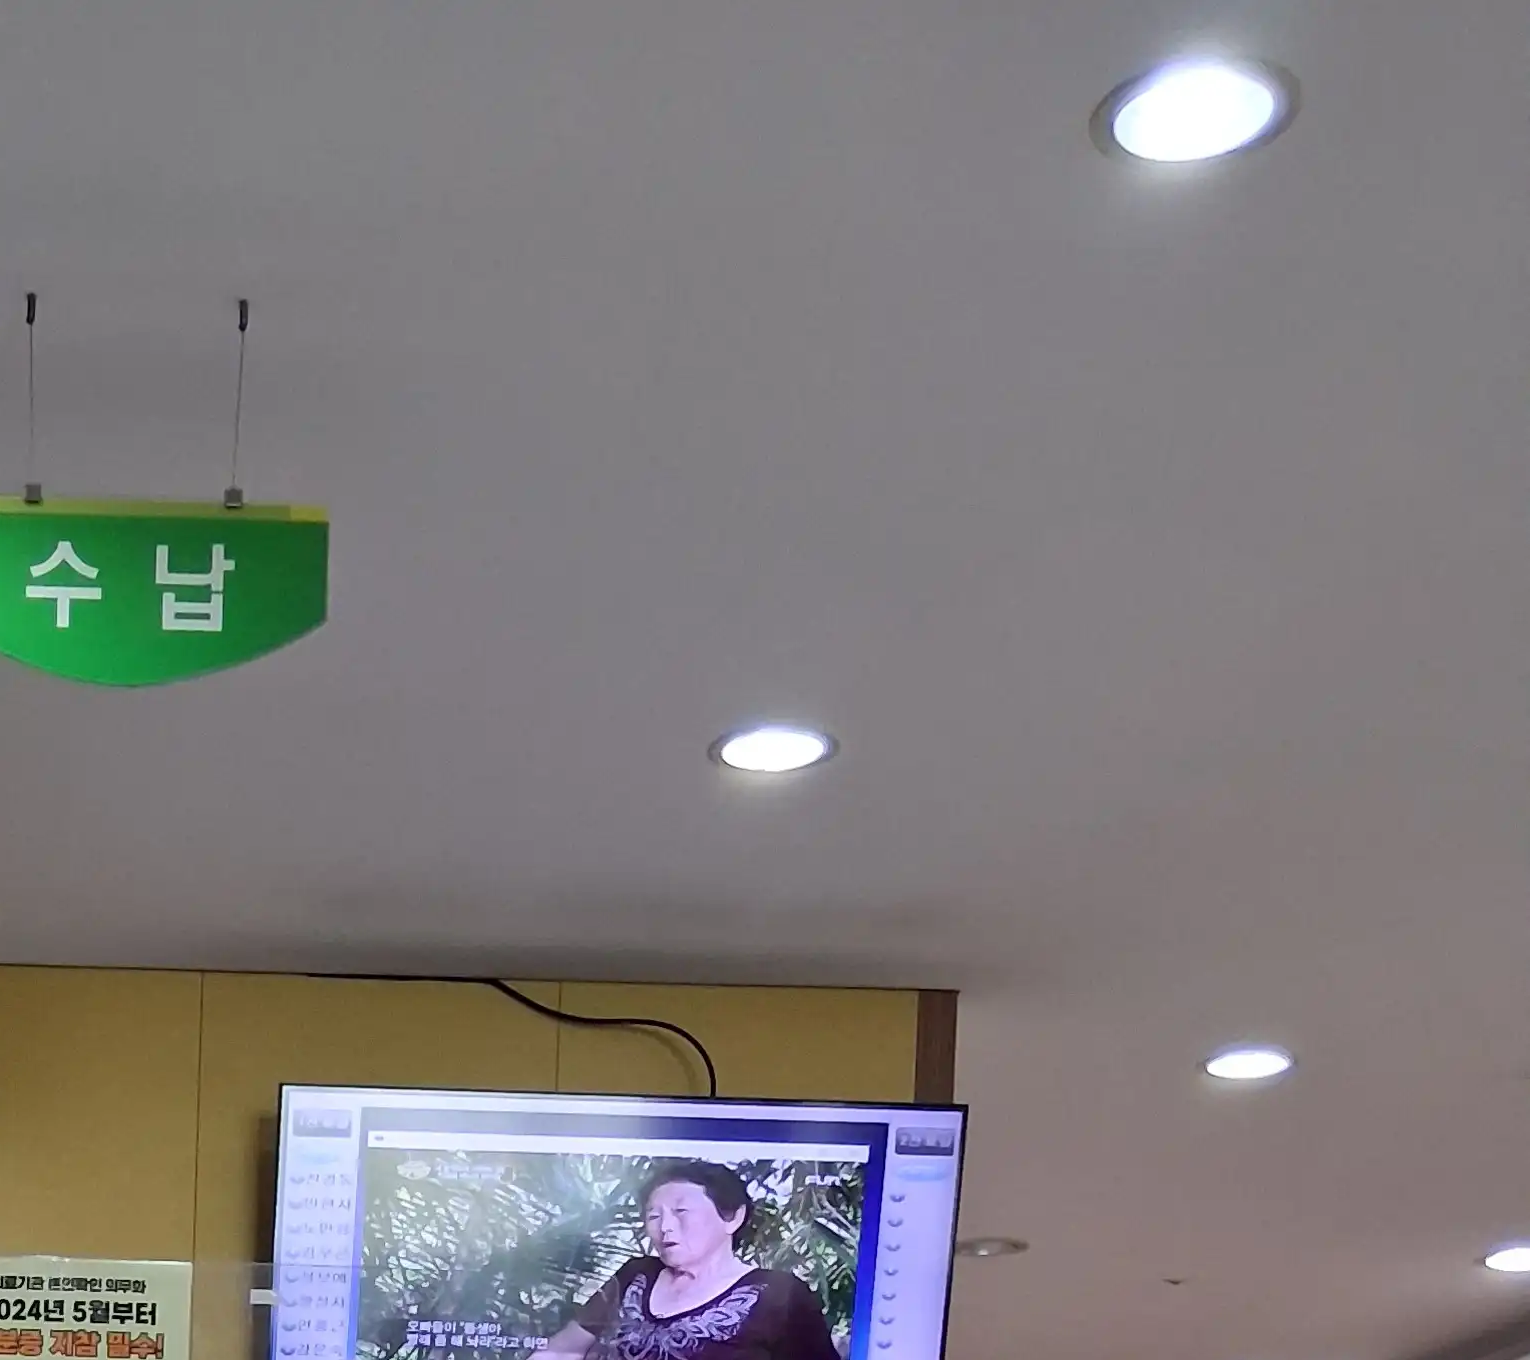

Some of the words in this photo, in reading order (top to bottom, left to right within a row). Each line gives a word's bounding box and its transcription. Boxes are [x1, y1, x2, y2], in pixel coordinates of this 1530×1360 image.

[49, 1277, 101, 1293] 본인확인
[106, 1279, 146, 1293] 의무화
[72, 1299, 157, 1325] 5월부터
[49, 1331, 101, 1357] 지참
[107, 1333, 164, 1359] 필수!
